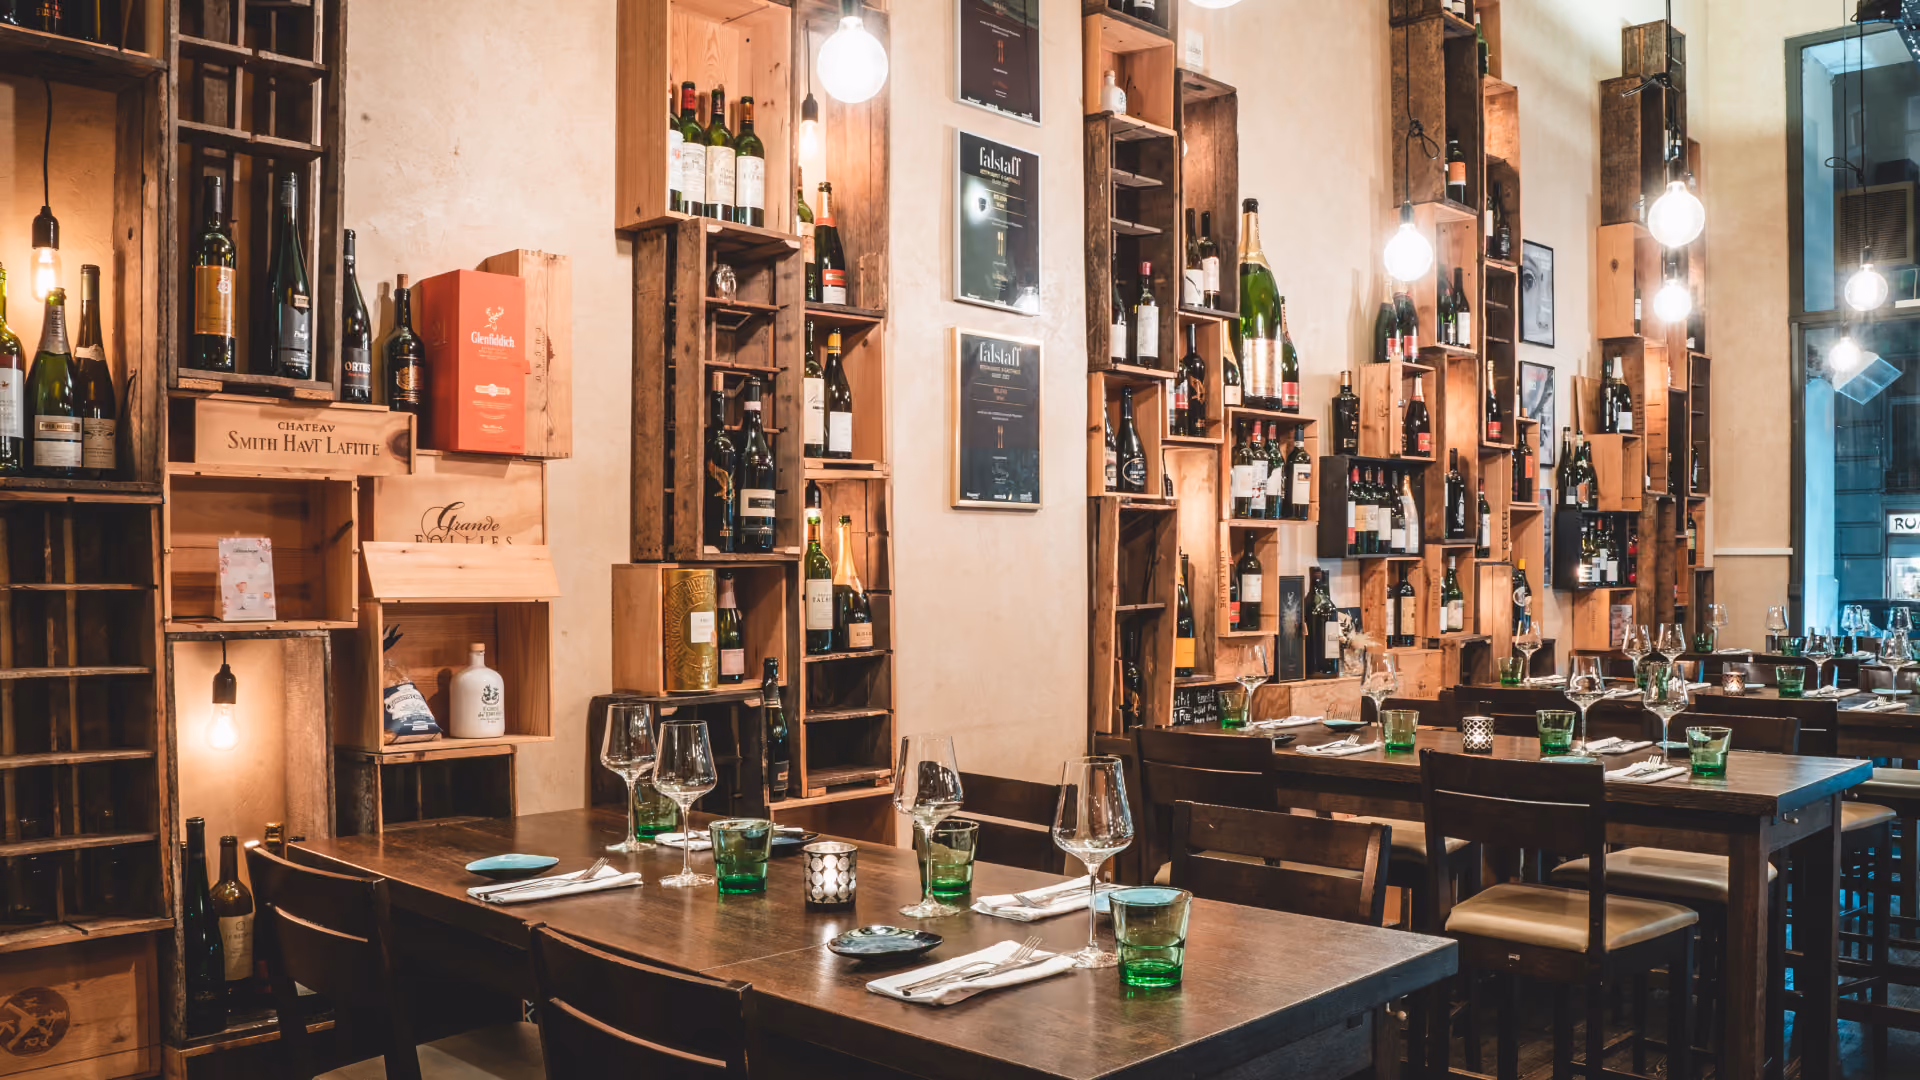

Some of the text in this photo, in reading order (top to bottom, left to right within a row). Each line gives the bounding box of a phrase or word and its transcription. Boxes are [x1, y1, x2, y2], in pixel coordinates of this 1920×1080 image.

[980, 147, 1021, 177] falstaff
[471, 331, 516, 348] Glenfiddich
[980, 342, 1021, 367] falstaff
[227, 430, 278, 451] SMITH
[326, 436, 380, 456] LAFITTE
[421, 501, 501, 542] Grande
[1894, 517, 1920, 530] RU
